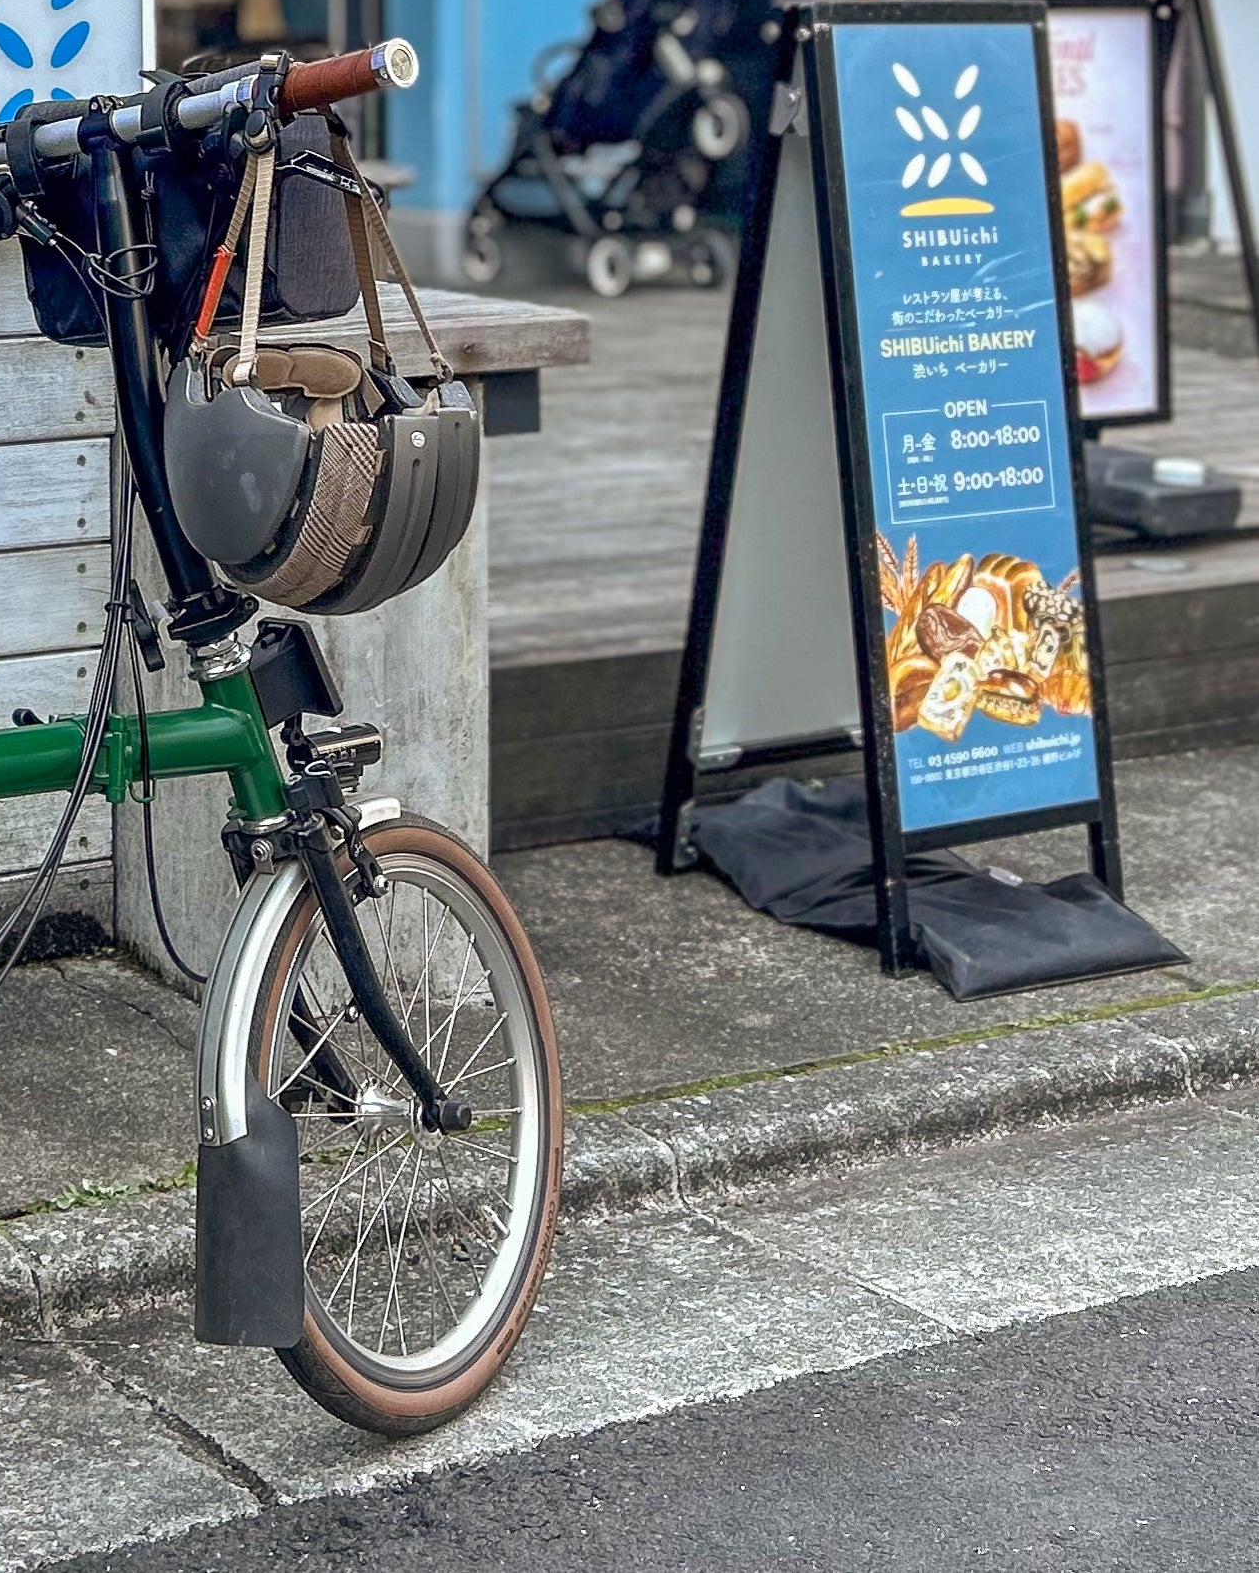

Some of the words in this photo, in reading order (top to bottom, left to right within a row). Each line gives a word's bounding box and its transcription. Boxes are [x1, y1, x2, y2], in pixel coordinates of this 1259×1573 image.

[902, 226, 998, 248] SHIBUichi
[921, 253, 982, 266] BAKERY
[880, 334, 964, 358] SHIBUichi
[968, 330, 1036, 352] BAKERY
[955, 359, 1009, 374] ベーカリー
[944, 399, 988, 419] OPEN
[950, 425, 1041, 450] 8:00-18:00
[953, 466, 1044, 492] 9:00-18:00
[907, 758, 925, 769] TEL
[1003, 742, 1024, 754] WEB
